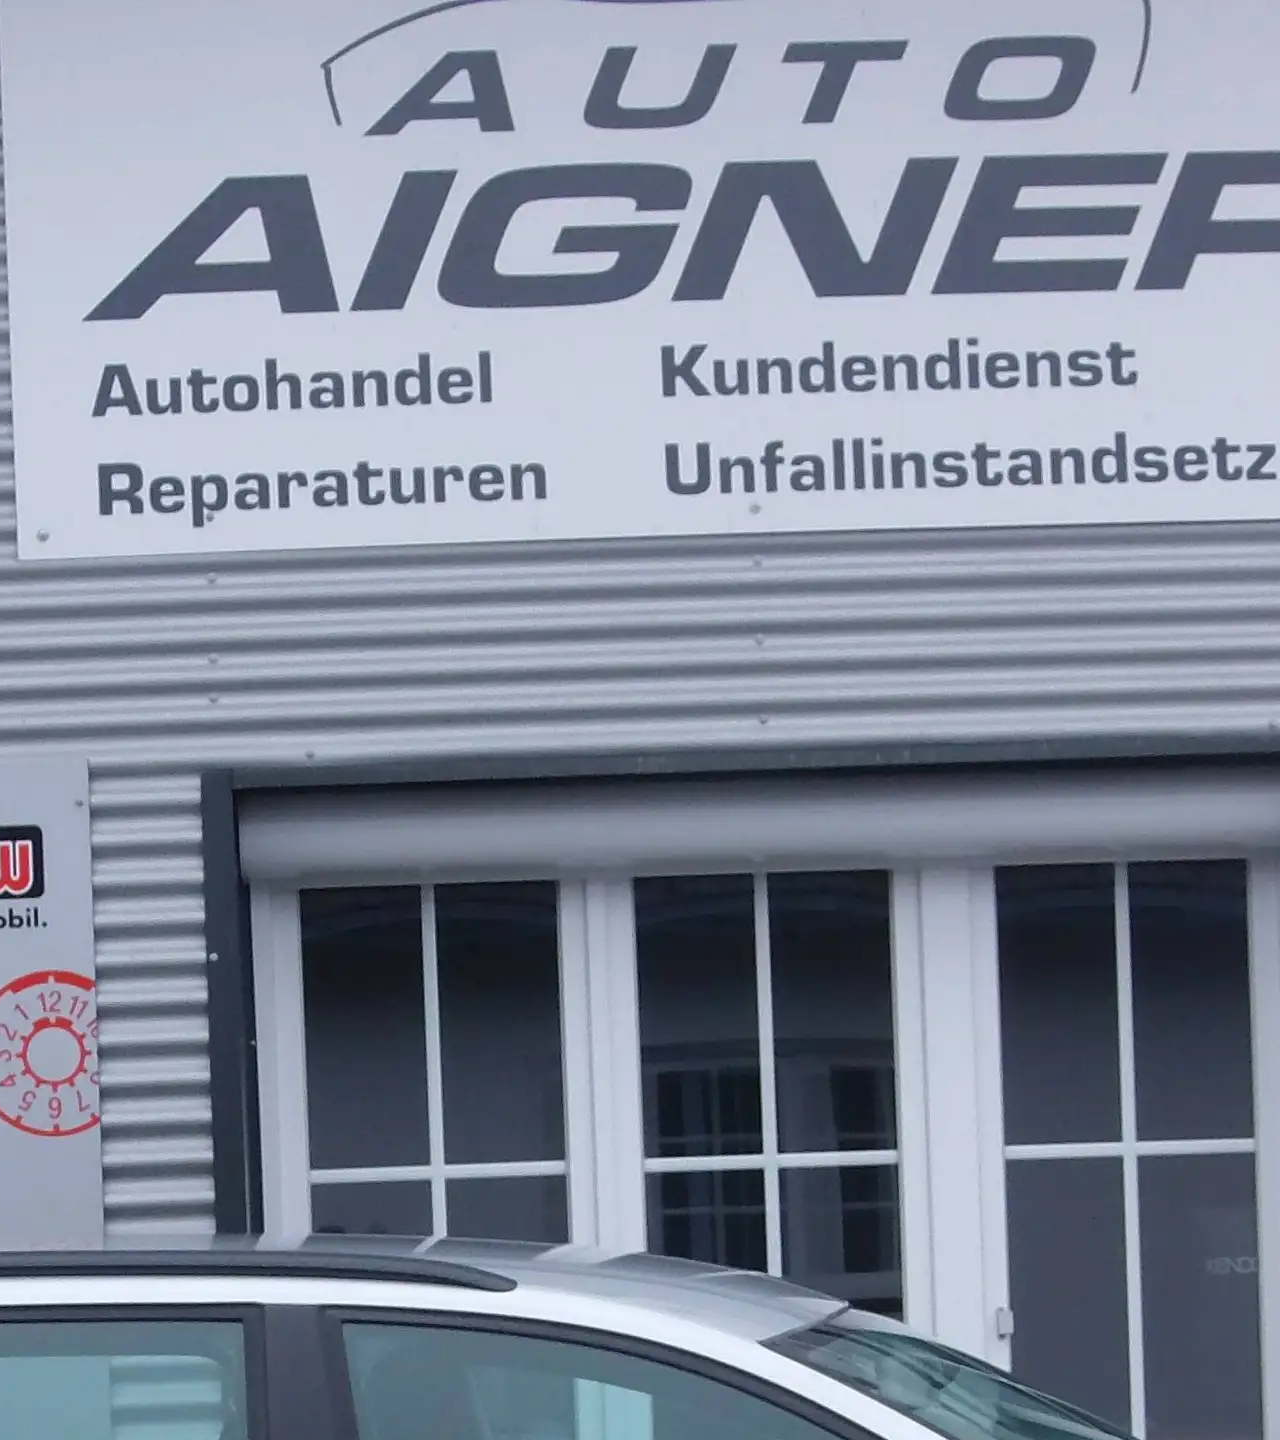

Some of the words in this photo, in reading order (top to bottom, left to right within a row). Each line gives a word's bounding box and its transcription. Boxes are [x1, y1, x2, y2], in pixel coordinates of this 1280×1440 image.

[365, 35, 1096, 136] AUTO
[91, 351, 493, 418] Autohandel
[660, 338, 1138, 398] Kundendienst
[97, 462, 547, 527] Reparaturen
[37, 990, 62, 1012] 12
[69, 995, 89, 1019] 11
